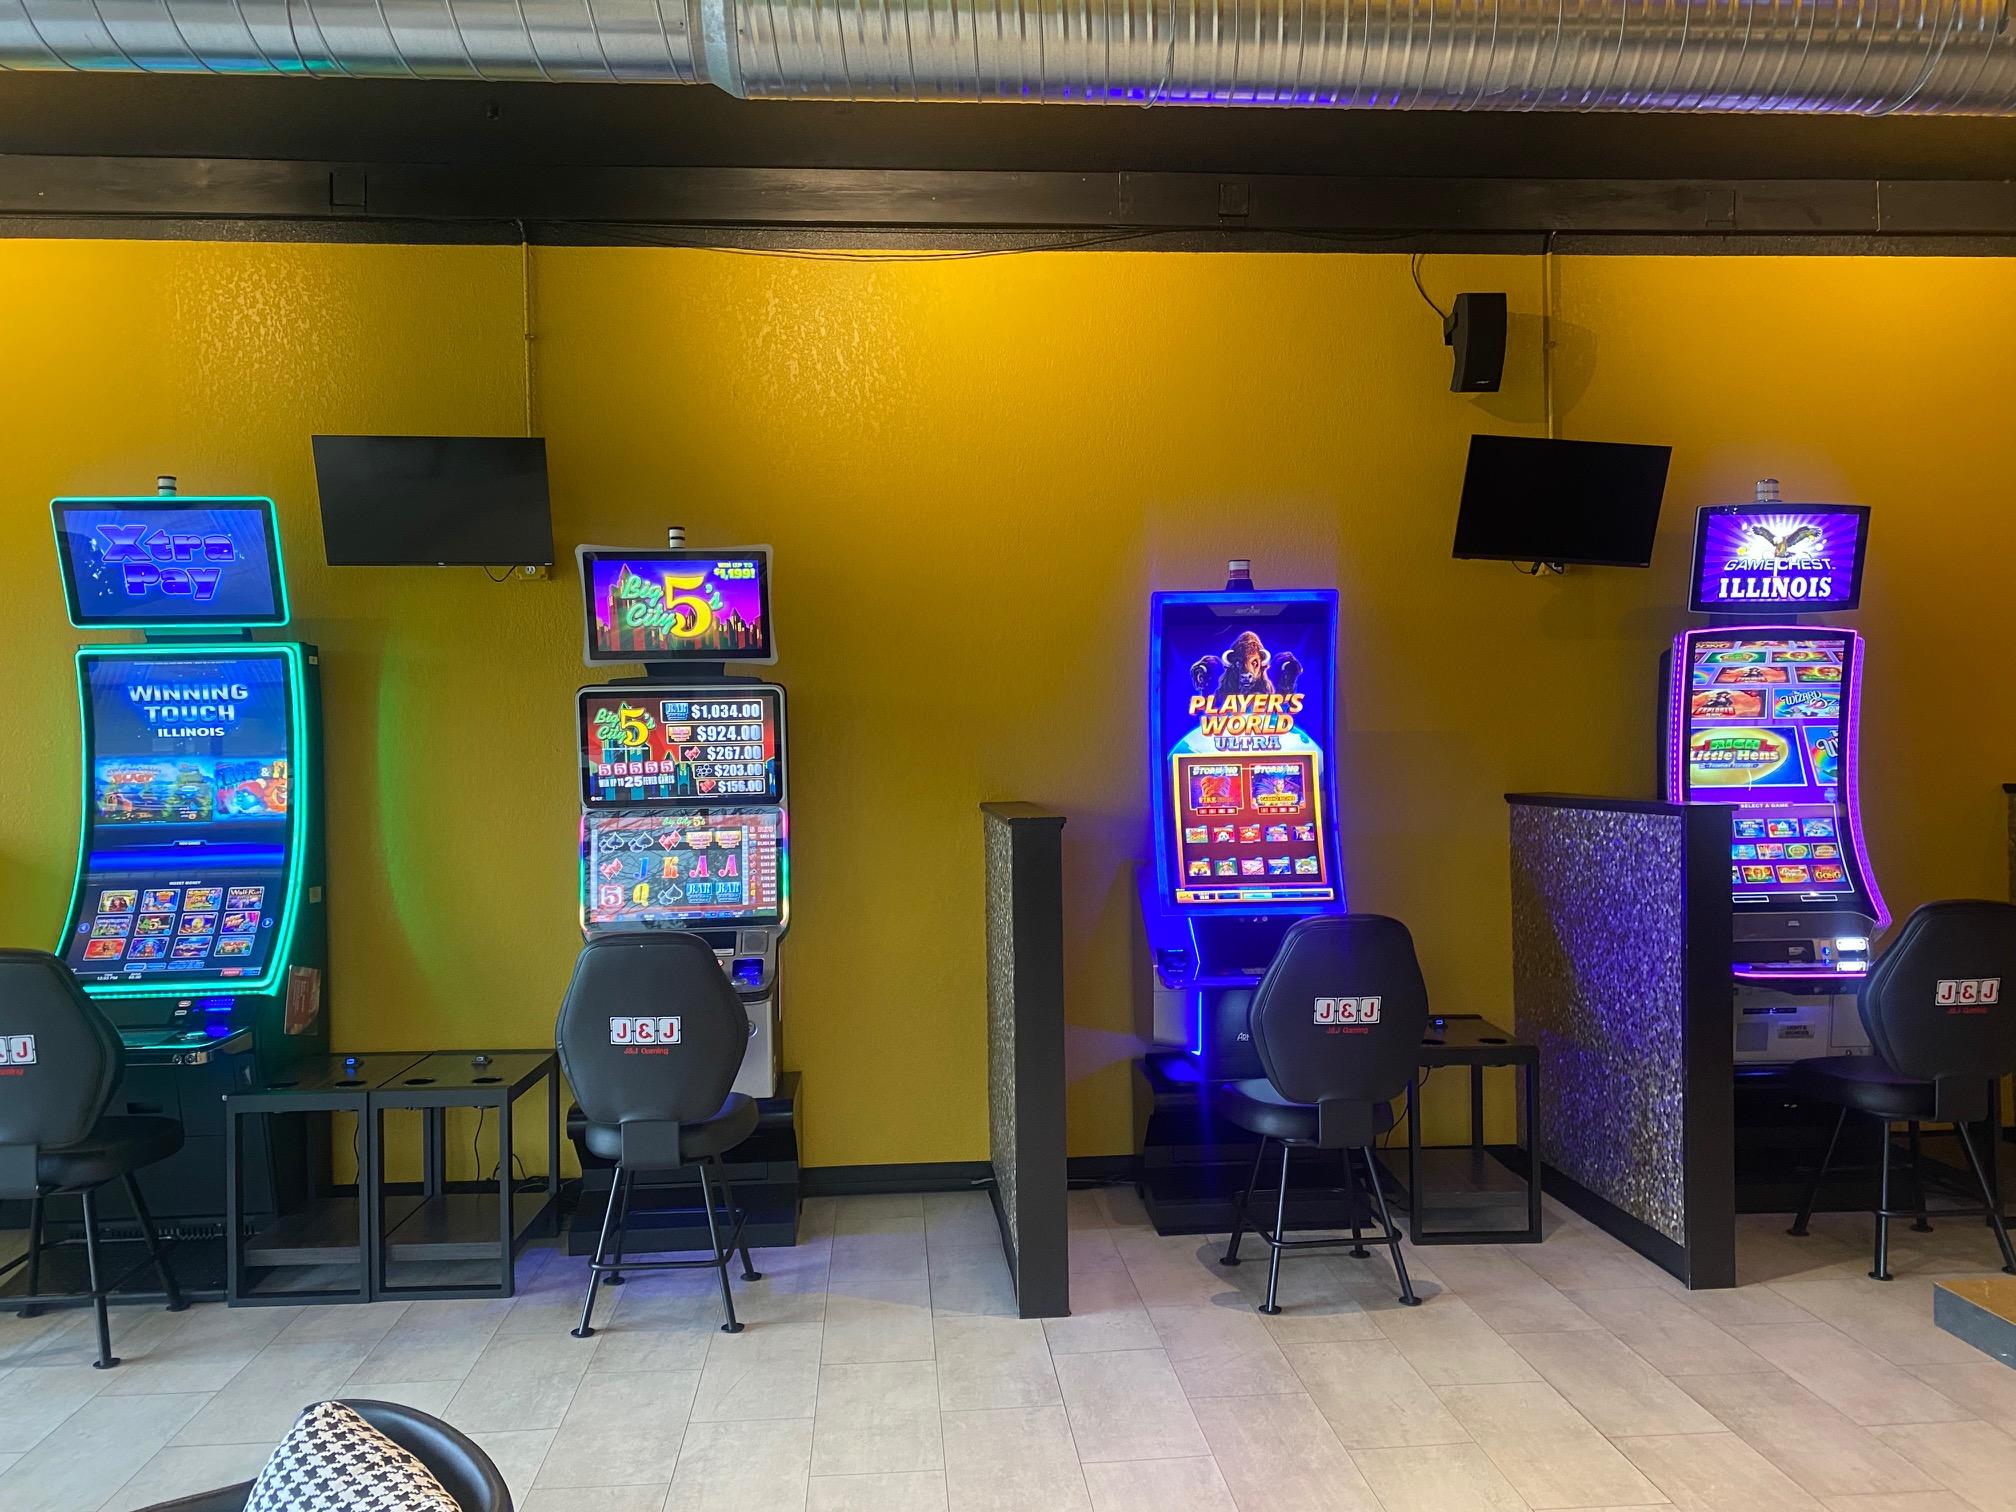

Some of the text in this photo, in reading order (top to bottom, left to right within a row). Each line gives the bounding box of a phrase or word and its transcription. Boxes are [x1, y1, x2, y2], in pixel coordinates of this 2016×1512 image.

[96, 524, 235, 562] Xtra
[123, 563, 222, 601] Pay
[620, 574, 664, 607] Big
[1718, 576, 1832, 599] ILLINOIS
[626, 600, 677, 635] City
[130, 683, 249, 703] WINNING
[1780, 689, 1823, 706] WIZARD
[691, 703, 760, 719] $1,034.00
[1189, 693, 1305, 715] PLAYER'S
[143, 705, 235, 723] TOUCH
[593, 708, 619, 725] Big
[157, 727, 225, 738] ILLINOIS
[1200, 714, 1294, 735] WORLD
[597, 724, 628, 744] City
[696, 725, 761, 742] $924.00
[1214, 736, 1281, 752] ULTRA
[707, 745, 762, 762] $267.00
[1690, 749, 1779, 762] Little Hens
[714, 763, 763, 778] $203.00
[625, 776, 643, 788] 25
[718, 779, 763, 794] $156.00
[689, 854, 709, 878] A
[718, 854, 739, 878] A
[632, 883, 650, 907] Q
[1342, 1026, 1369, 1034] Gaming
[641, 1047, 669, 1056] Gaming
